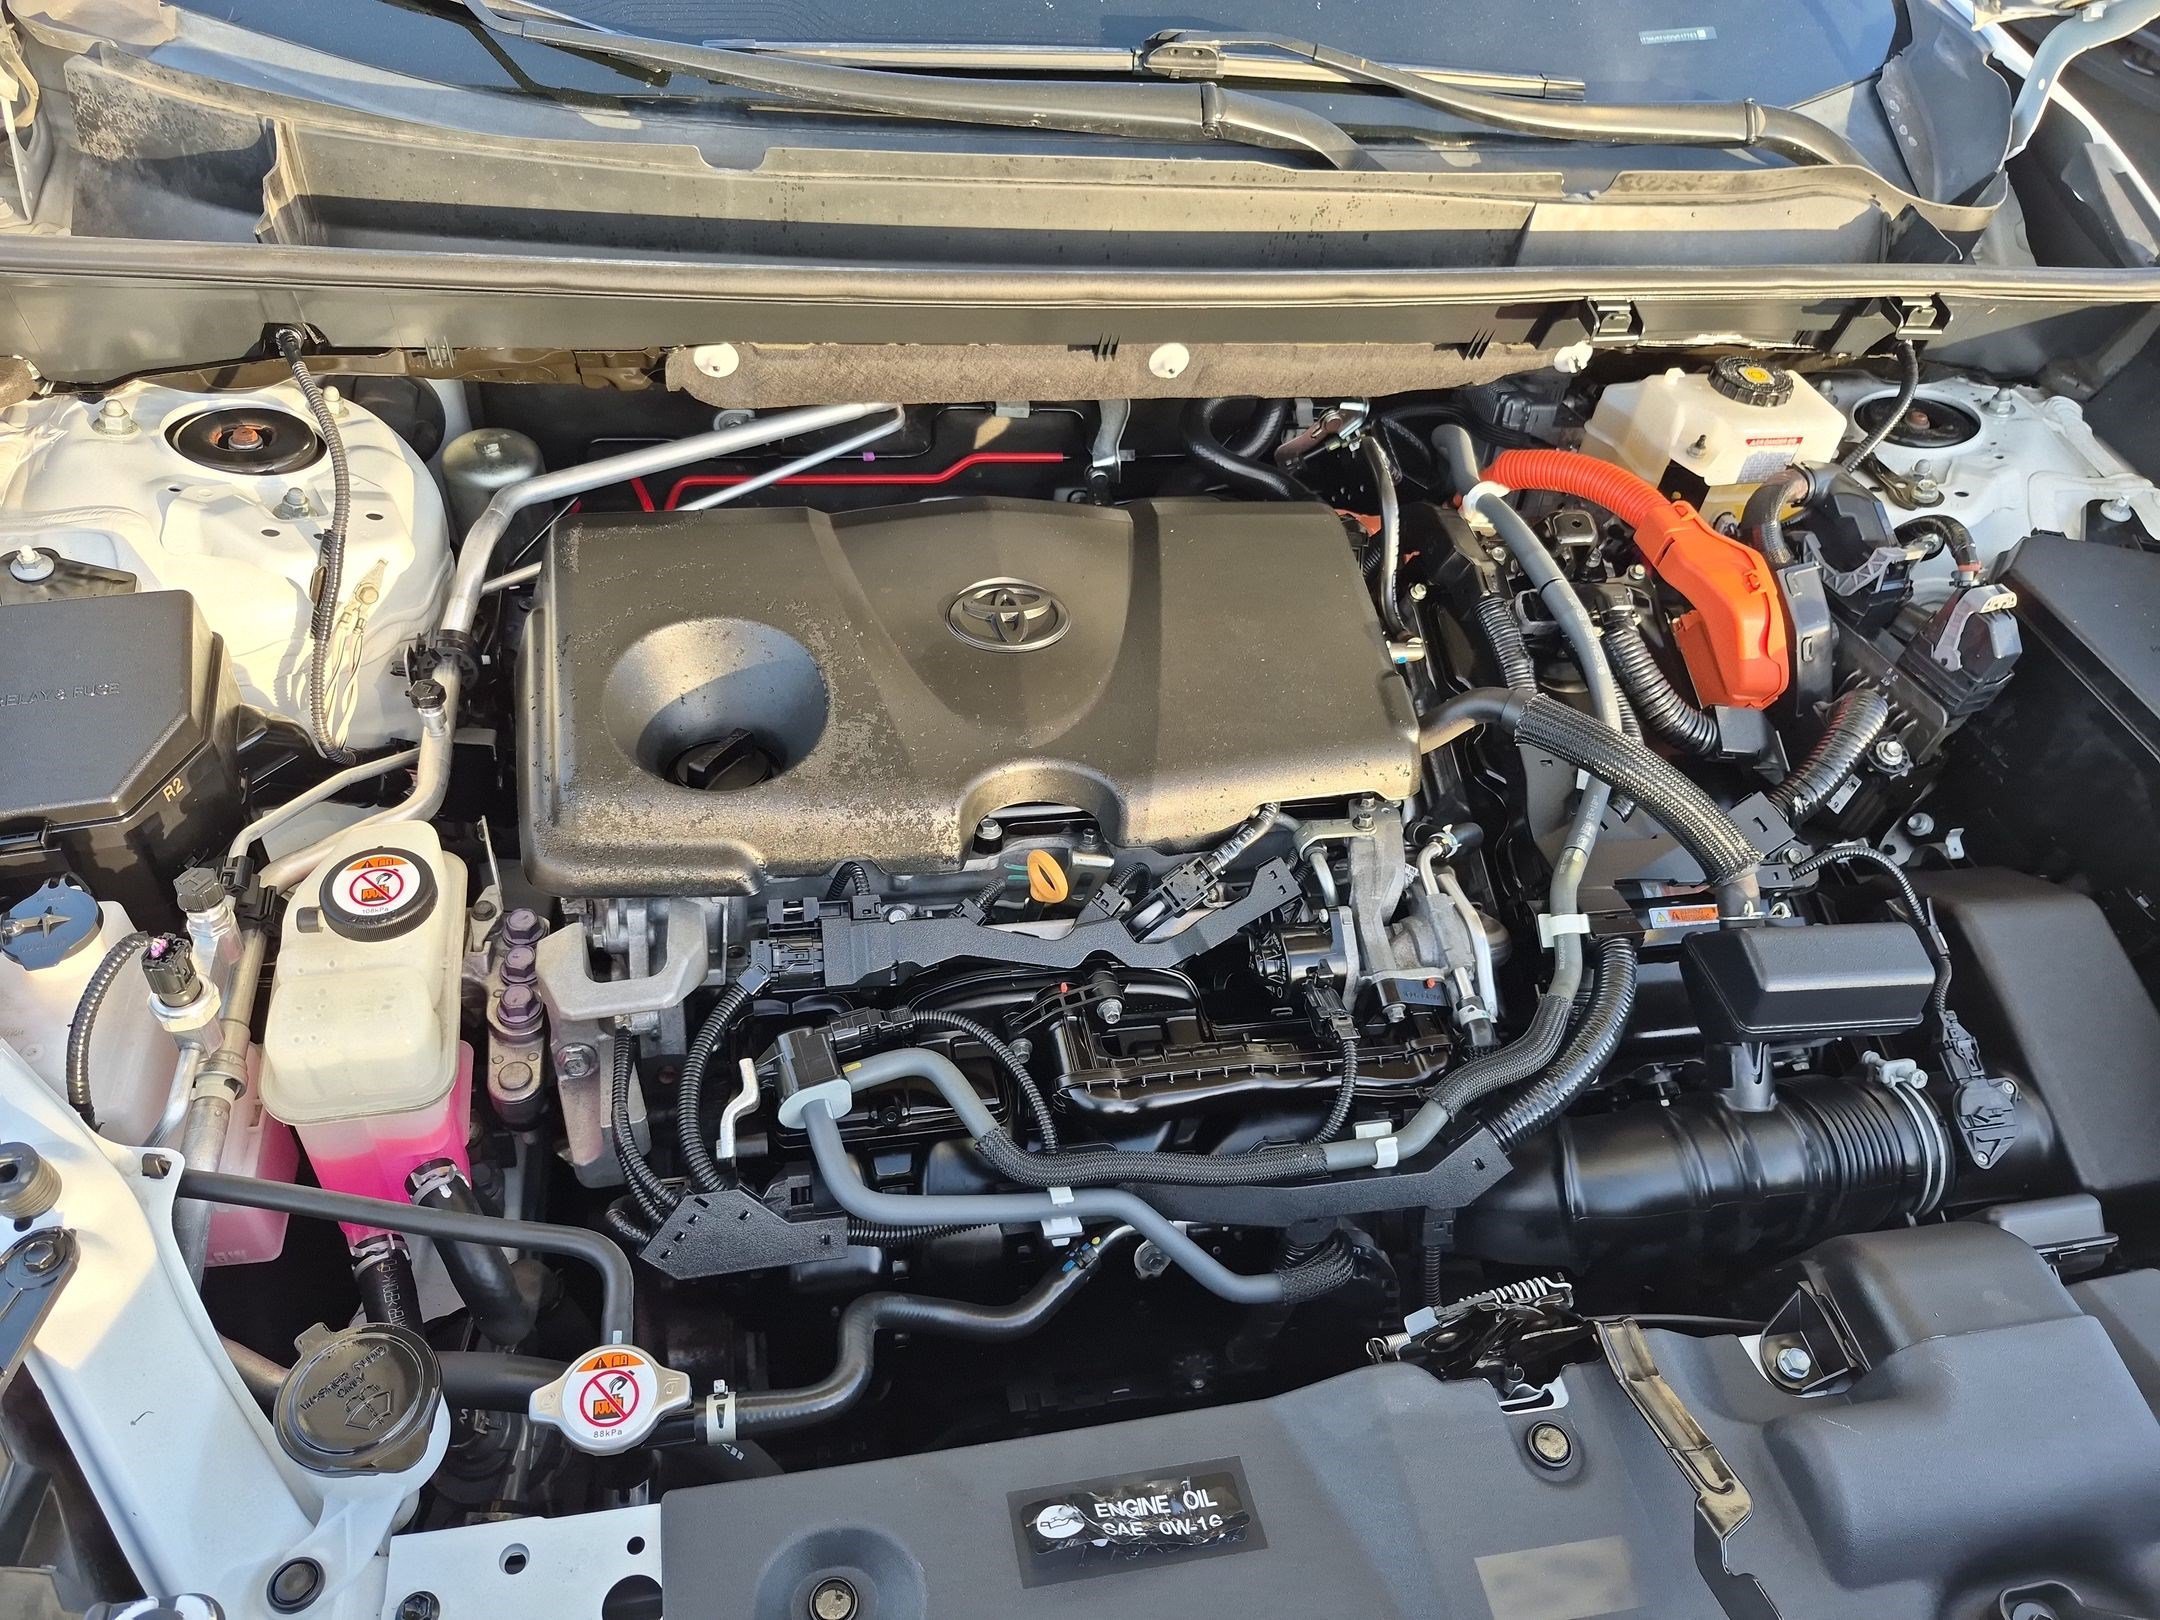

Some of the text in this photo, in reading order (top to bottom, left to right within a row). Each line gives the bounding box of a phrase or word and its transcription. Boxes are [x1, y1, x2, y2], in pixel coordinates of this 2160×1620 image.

[72, 682, 120, 698] FUSE
[162, 777, 184, 802] R2
[593, 1430, 623, 1438] 88kPa
[1094, 1488, 1218, 1518] ENGINE OIL
[1102, 1521, 1147, 1536] SAE
